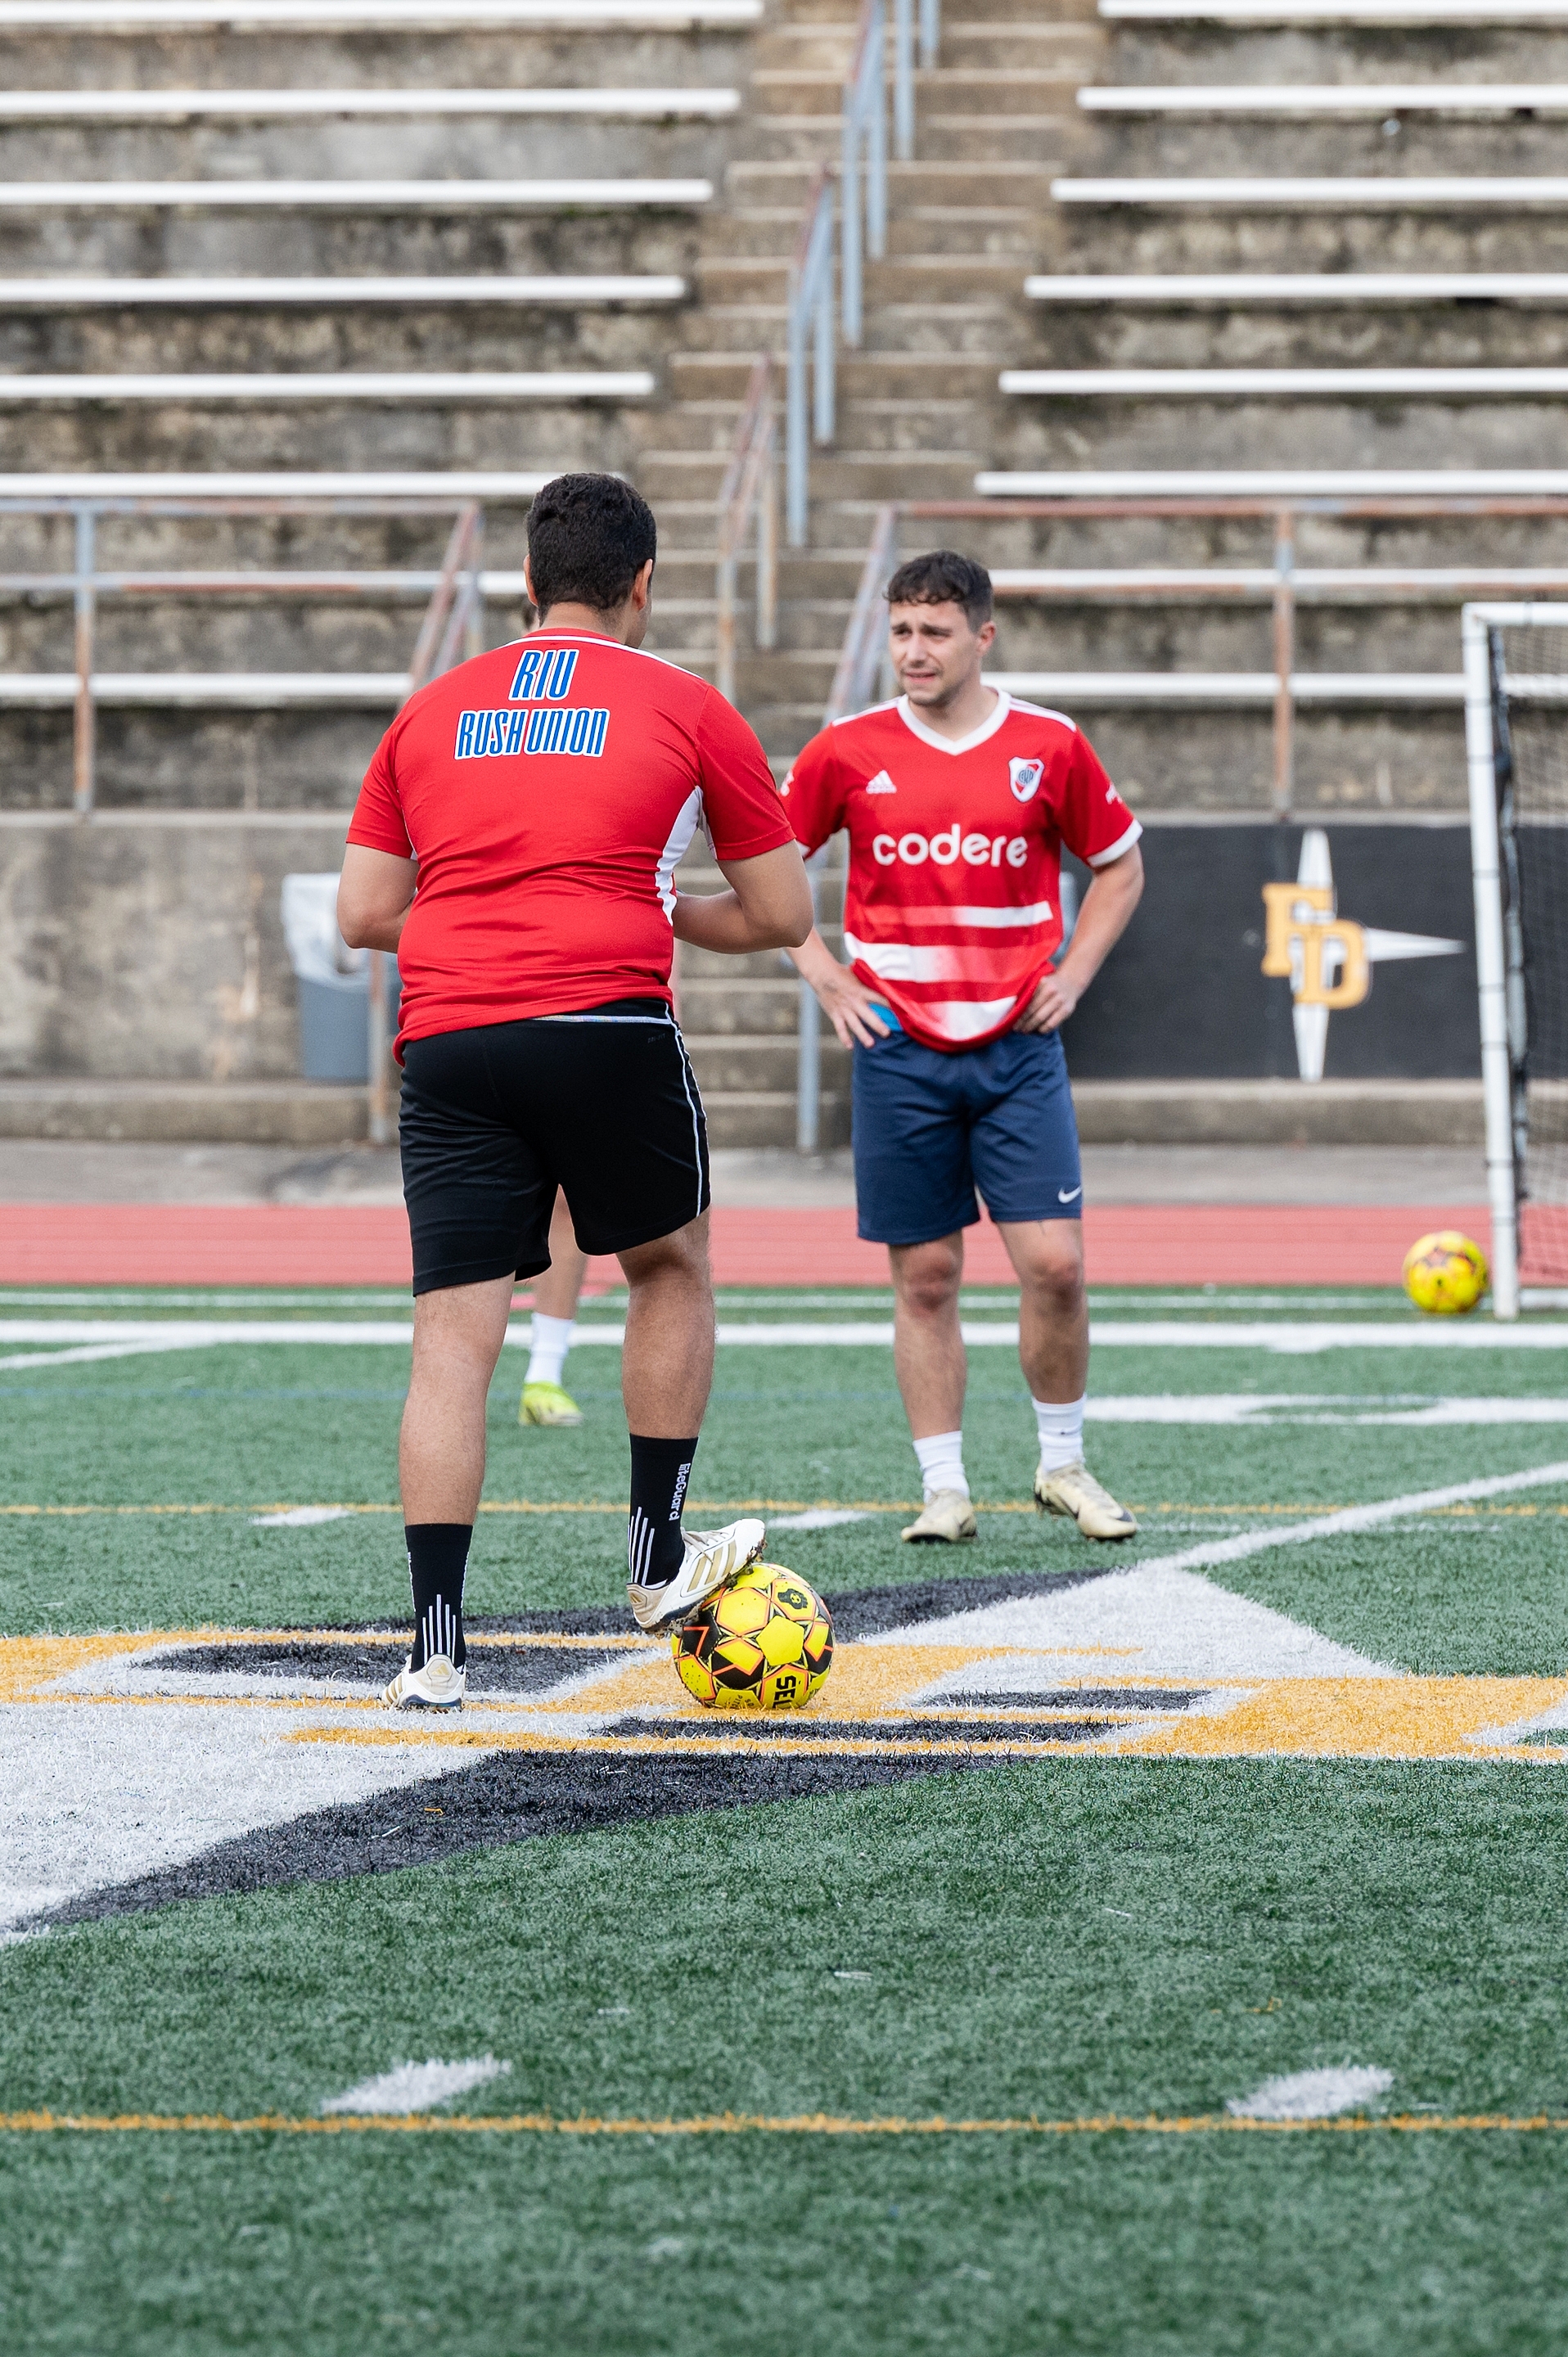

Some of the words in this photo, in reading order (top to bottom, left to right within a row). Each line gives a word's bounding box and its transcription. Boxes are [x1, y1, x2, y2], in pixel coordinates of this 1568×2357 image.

[508, 649, 579, 701] RIU
[454, 709, 529, 759] RUSH
[524, 707, 611, 758] UNION
[872, 823, 1028, 868] codere
